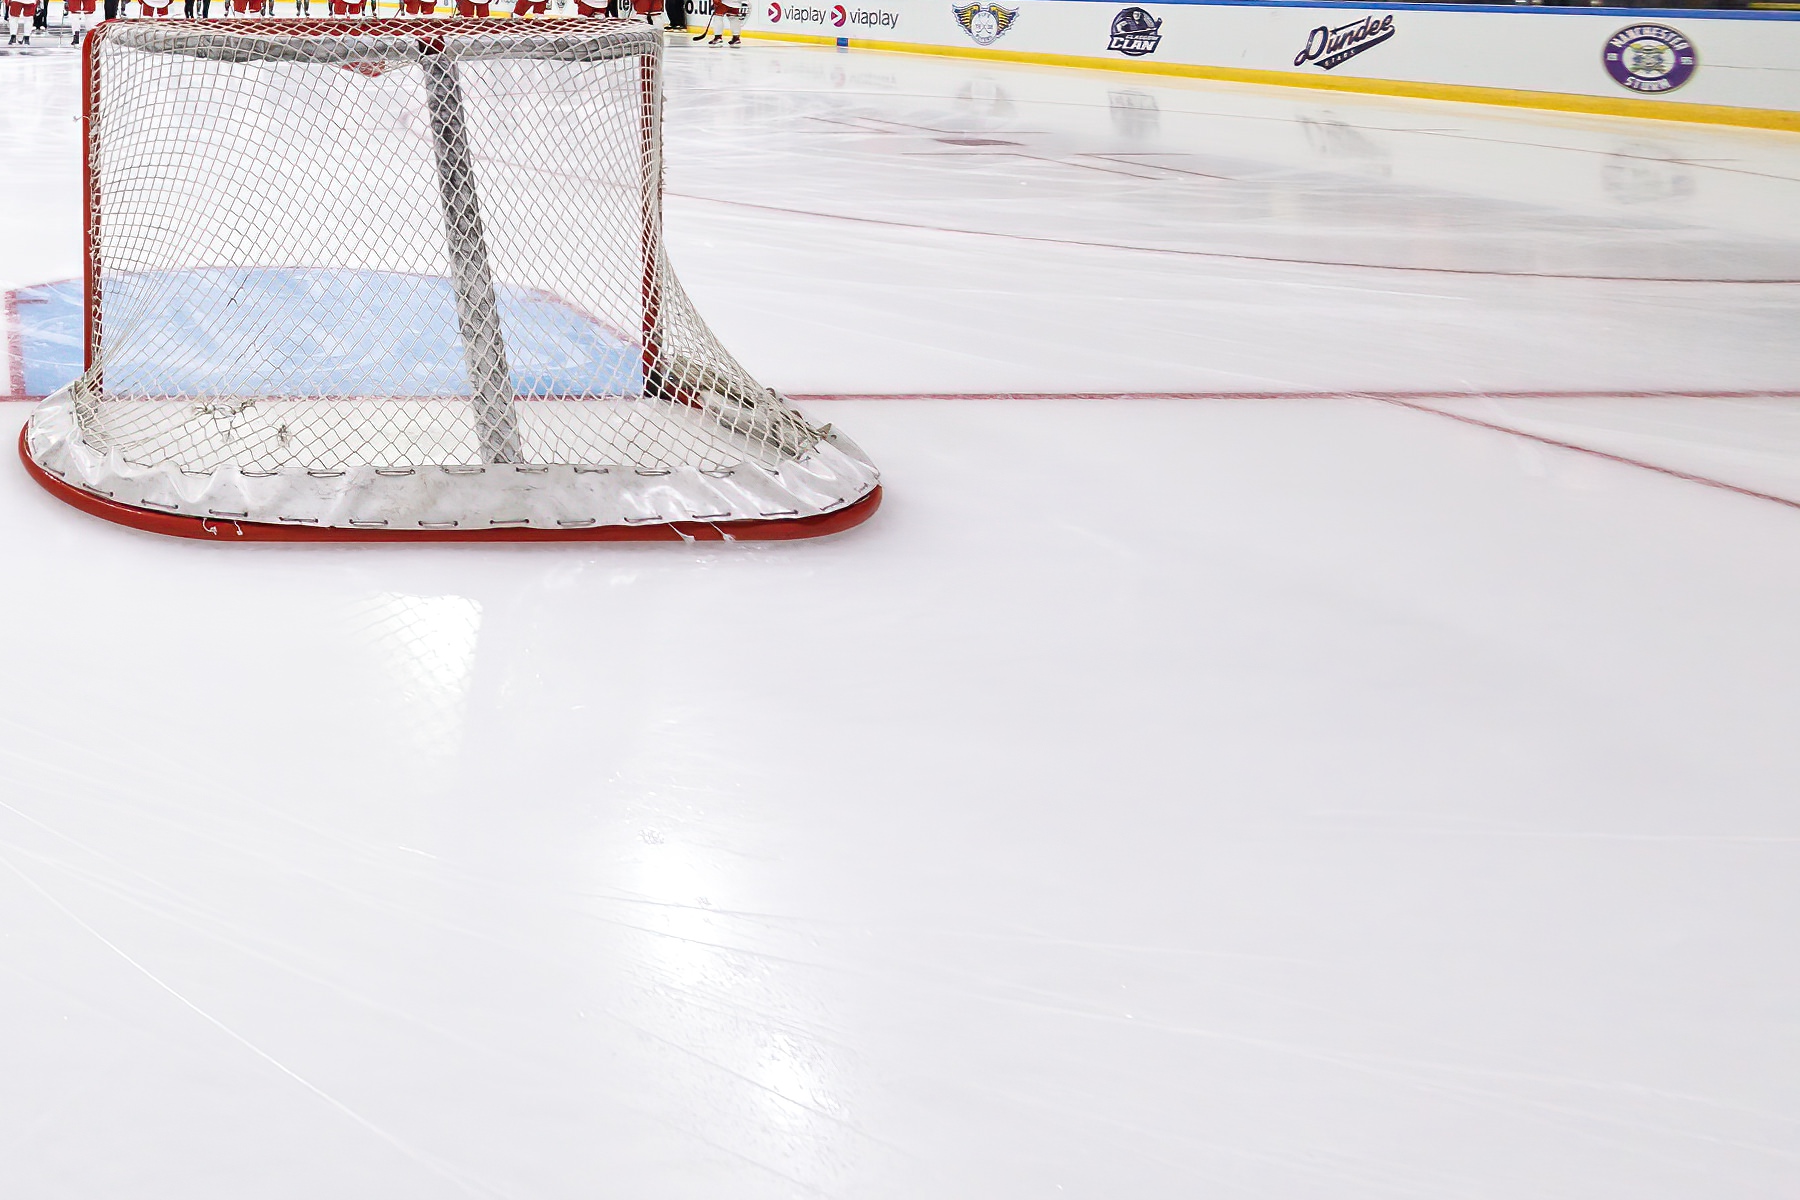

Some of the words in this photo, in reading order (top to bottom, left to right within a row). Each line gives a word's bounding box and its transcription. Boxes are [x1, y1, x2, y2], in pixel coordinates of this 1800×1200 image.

[784, 6, 826, 25] viaplay
[850, 9, 899, 29] viaplay
[1111, 36, 1155, 51] CLAN
[1294, 14, 1395, 67] Dundee
